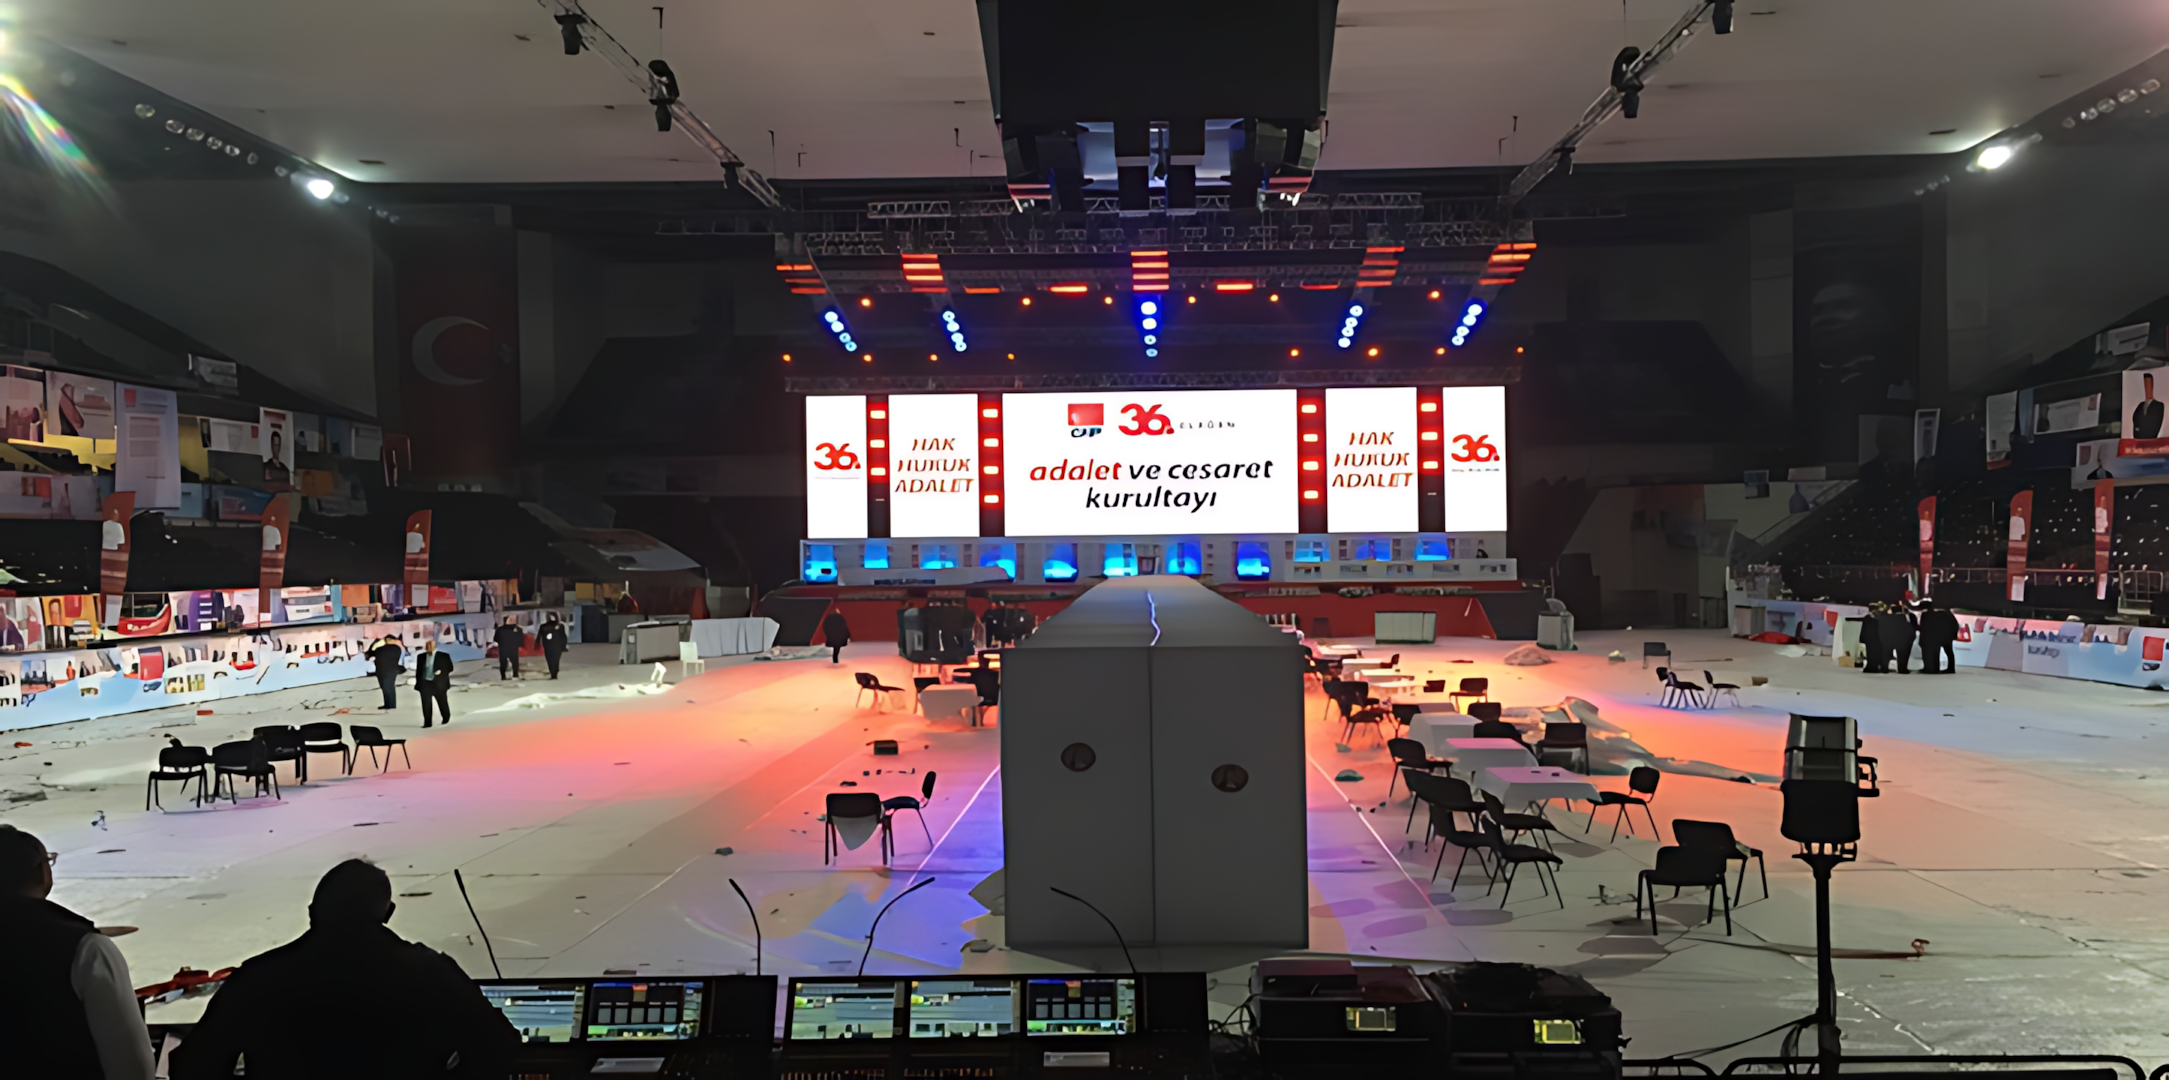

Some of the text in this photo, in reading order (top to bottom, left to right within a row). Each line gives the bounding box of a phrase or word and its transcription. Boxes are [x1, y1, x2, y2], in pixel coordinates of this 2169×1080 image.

[911, 437, 956, 452] HAK
[1348, 431, 1396, 446] HAK
[897, 458, 971, 473] HUKUK
[1334, 452, 1411, 468] HUKUK
[1029, 458, 1274, 481] adalet ve cesaret
[894, 478, 975, 494] ADALET
[1331, 472, 1414, 488] ADALET
[1085, 485, 1217, 514] kurultayı
